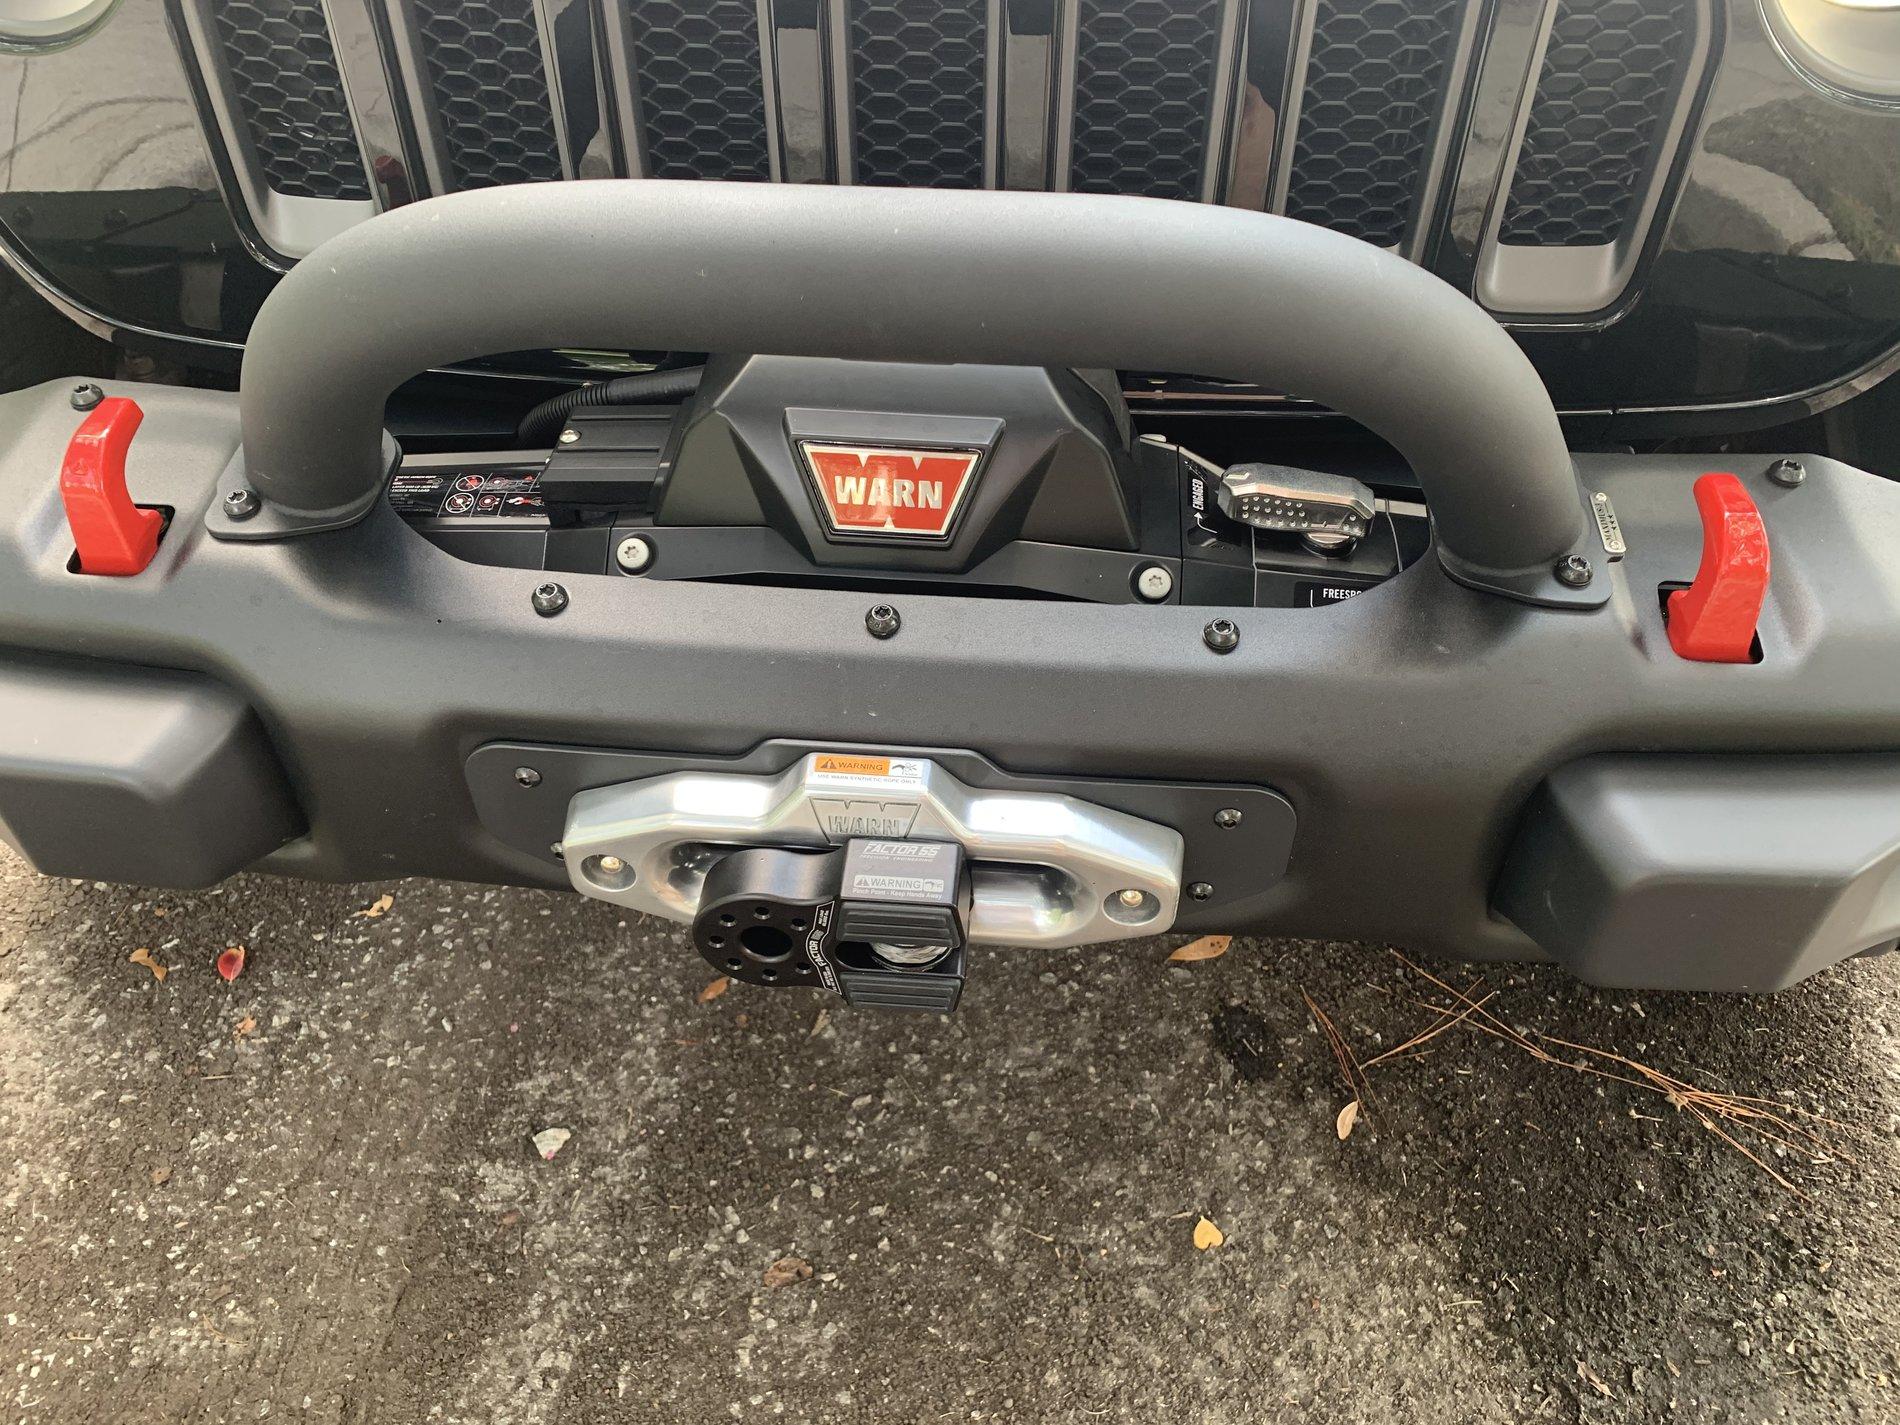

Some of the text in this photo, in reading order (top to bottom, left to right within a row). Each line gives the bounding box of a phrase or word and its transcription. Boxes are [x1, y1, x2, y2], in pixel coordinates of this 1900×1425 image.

[834, 475, 943, 510] WARN
[1192, 478, 1204, 511] ENGAGED
[838, 761, 883, 771] WARNING
[850, 775, 881, 783] SYNTHETIC
[828, 815, 900, 836] WARN
[863, 841, 942, 857] FACTOR 55
[870, 878, 921, 889] WARNING
[852, 887, 870, 895] Pinch
[870, 888, 886, 896] Point
[890, 890, 906, 898] Keep
[906, 890, 925, 899] Hands
[925, 892, 943, 901] Away
[809, 940, 828, 967] FACTOR
